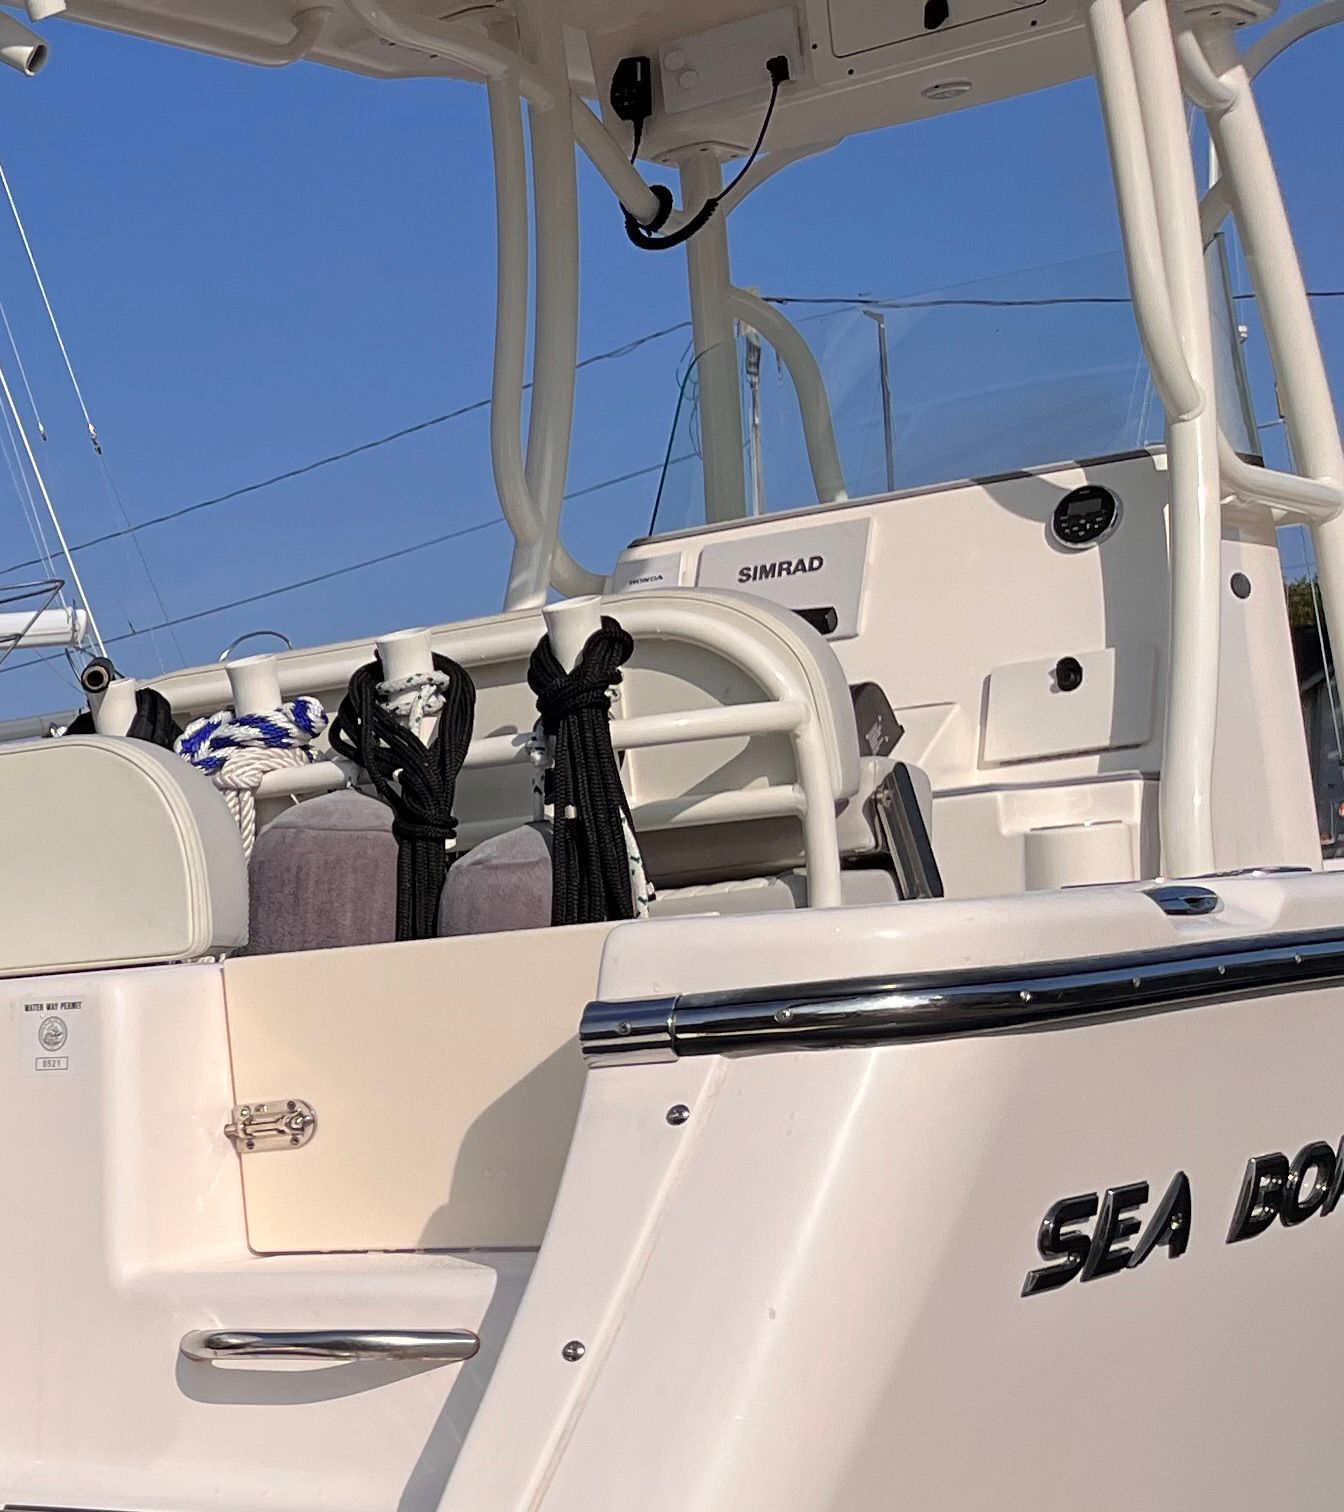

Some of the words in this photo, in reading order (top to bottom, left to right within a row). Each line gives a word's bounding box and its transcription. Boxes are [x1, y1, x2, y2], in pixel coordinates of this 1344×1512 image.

[737, 555, 824, 583] SIMRAD
[24, 1003, 44, 1012] WATER
[46, 1003, 59, 1011] WAY
[1020, 1170, 1192, 1297] SEA
